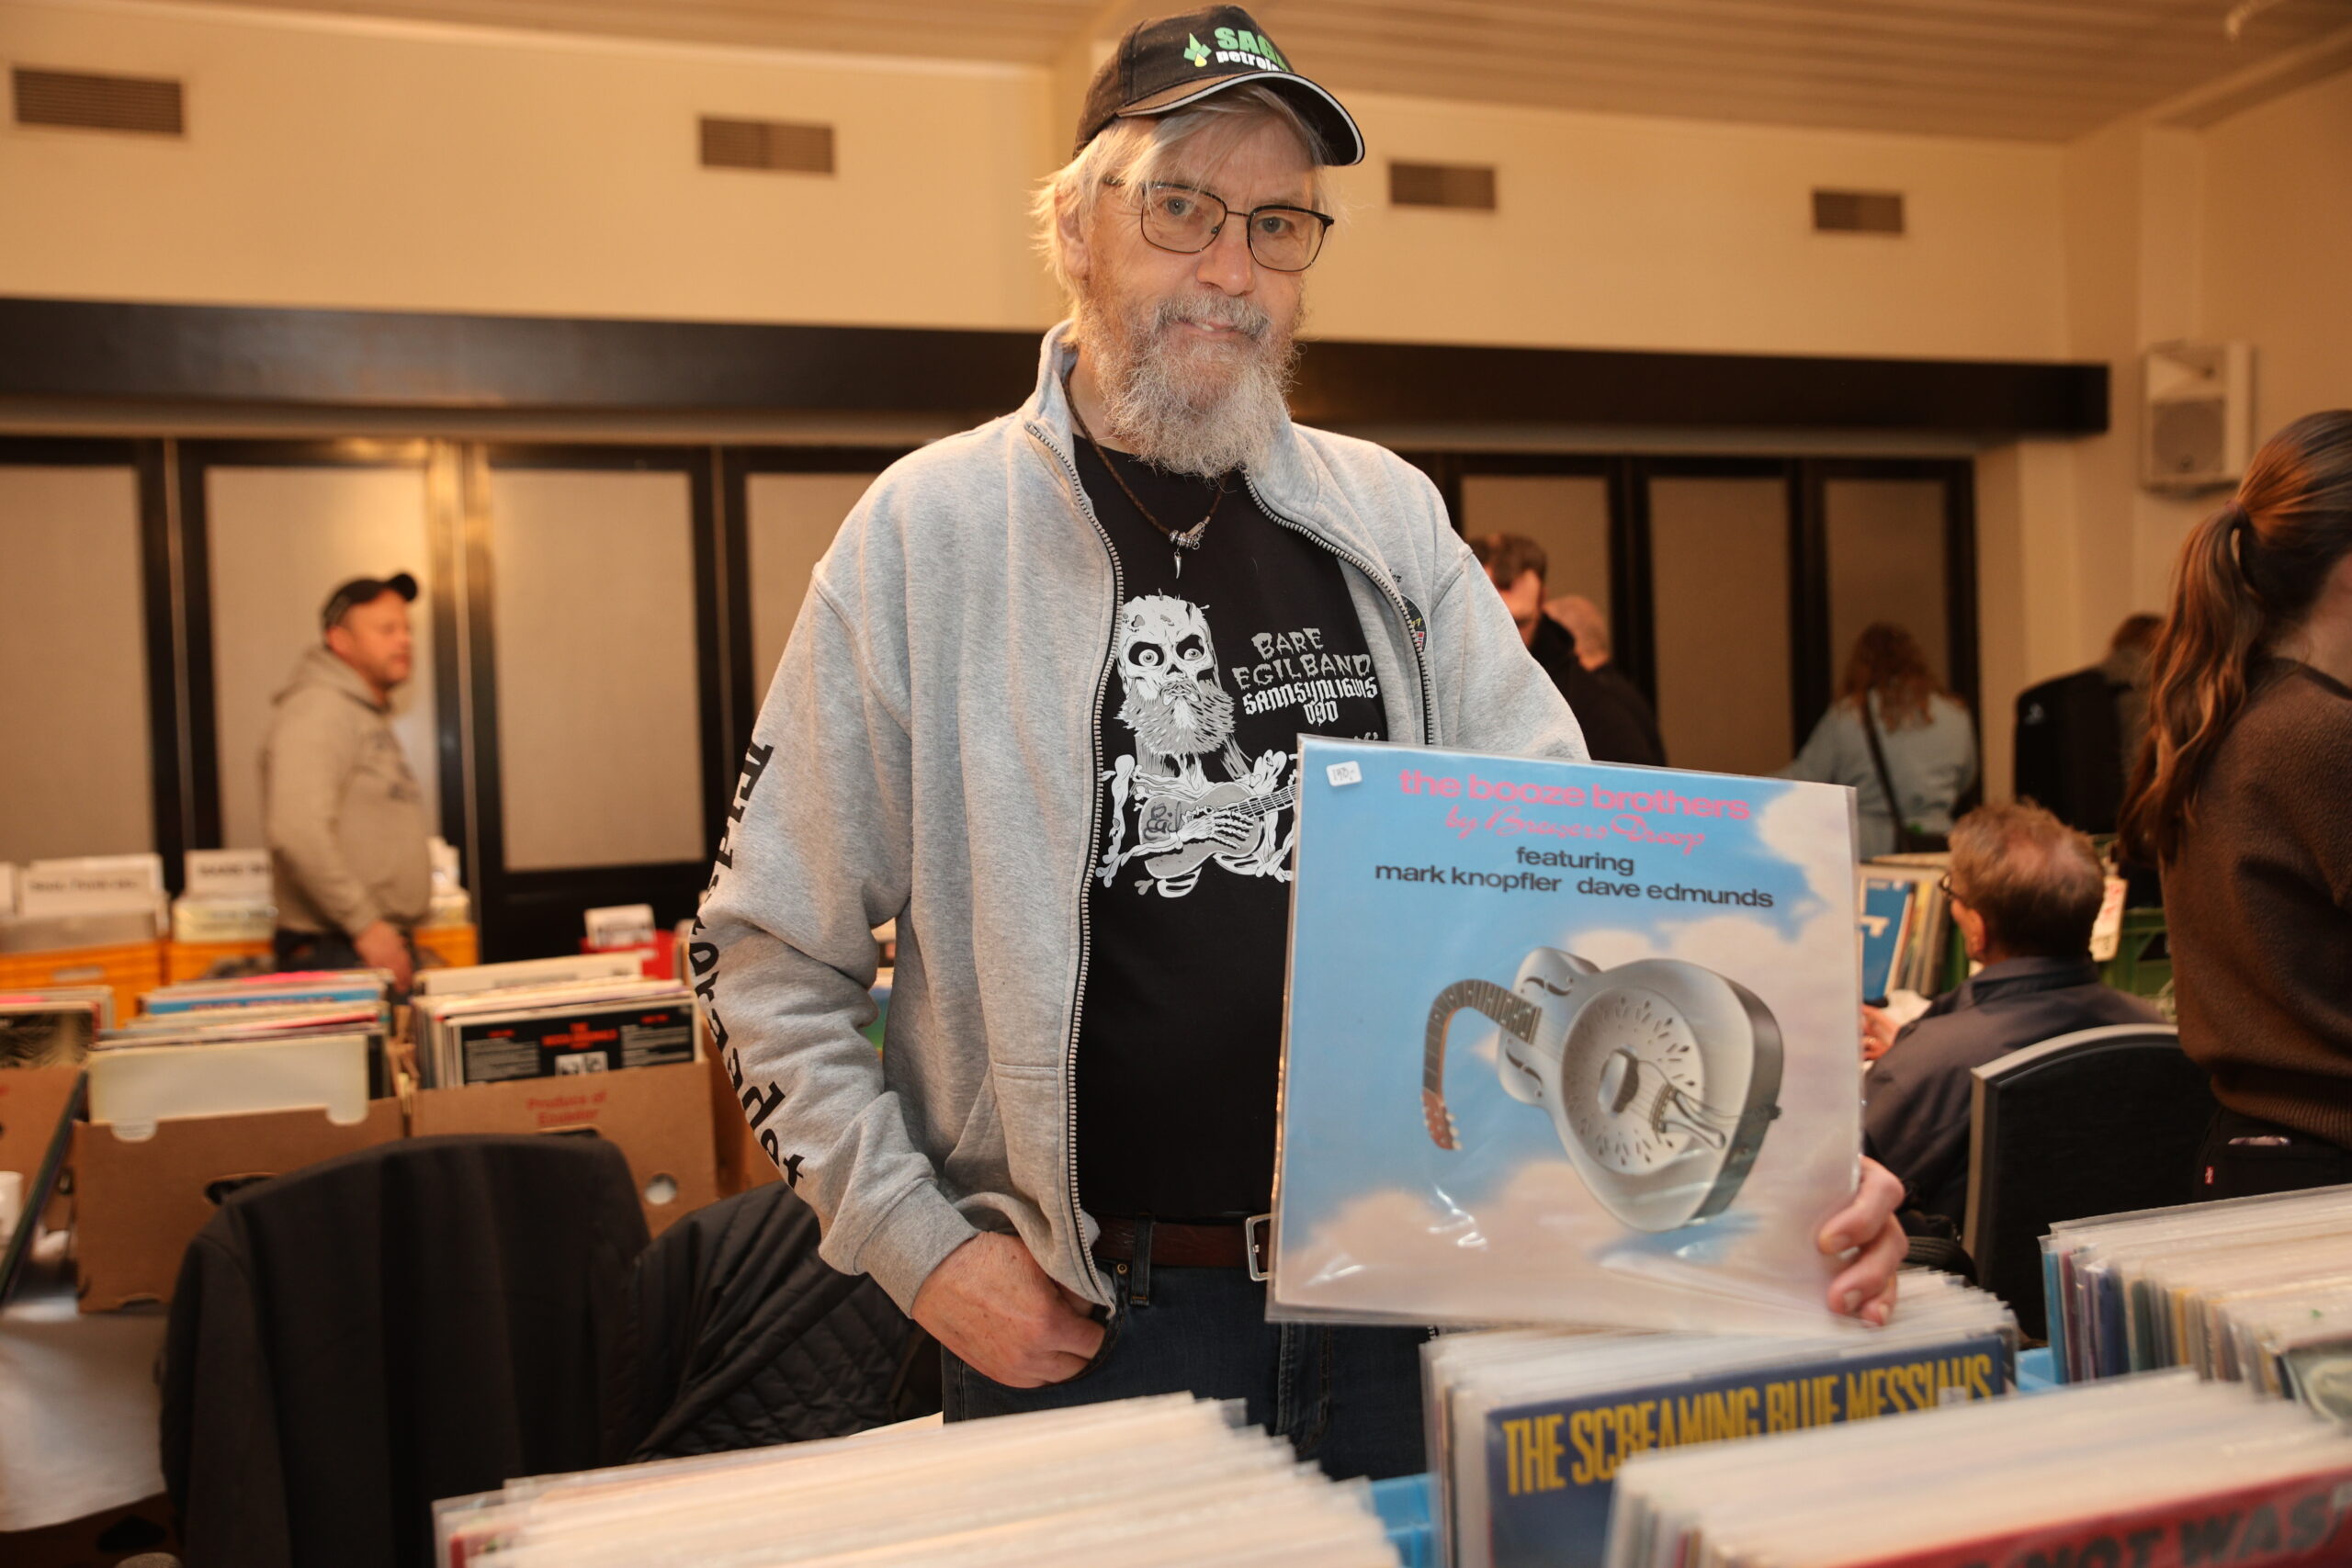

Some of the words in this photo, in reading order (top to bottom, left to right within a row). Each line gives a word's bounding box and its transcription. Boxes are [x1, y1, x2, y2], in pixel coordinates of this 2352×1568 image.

[1216, 50, 1283, 72] petrol
[1251, 627, 1324, 660] BARE
[1399, 769, 1462, 798] the
[1467, 773, 1586, 807] booze
[1591, 784, 1750, 820] brothers
[1445, 805, 1478, 840] by
[1516, 847, 1634, 876] featuring
[1375, 865, 1446, 885] mark
[1452, 867, 1563, 894] knopfler
[1577, 876, 1641, 898] dave
[1646, 883, 1774, 908] edmunds
[1502, 1413, 1566, 1495] THE
[1569, 1388, 1760, 1486] SCREAMING
